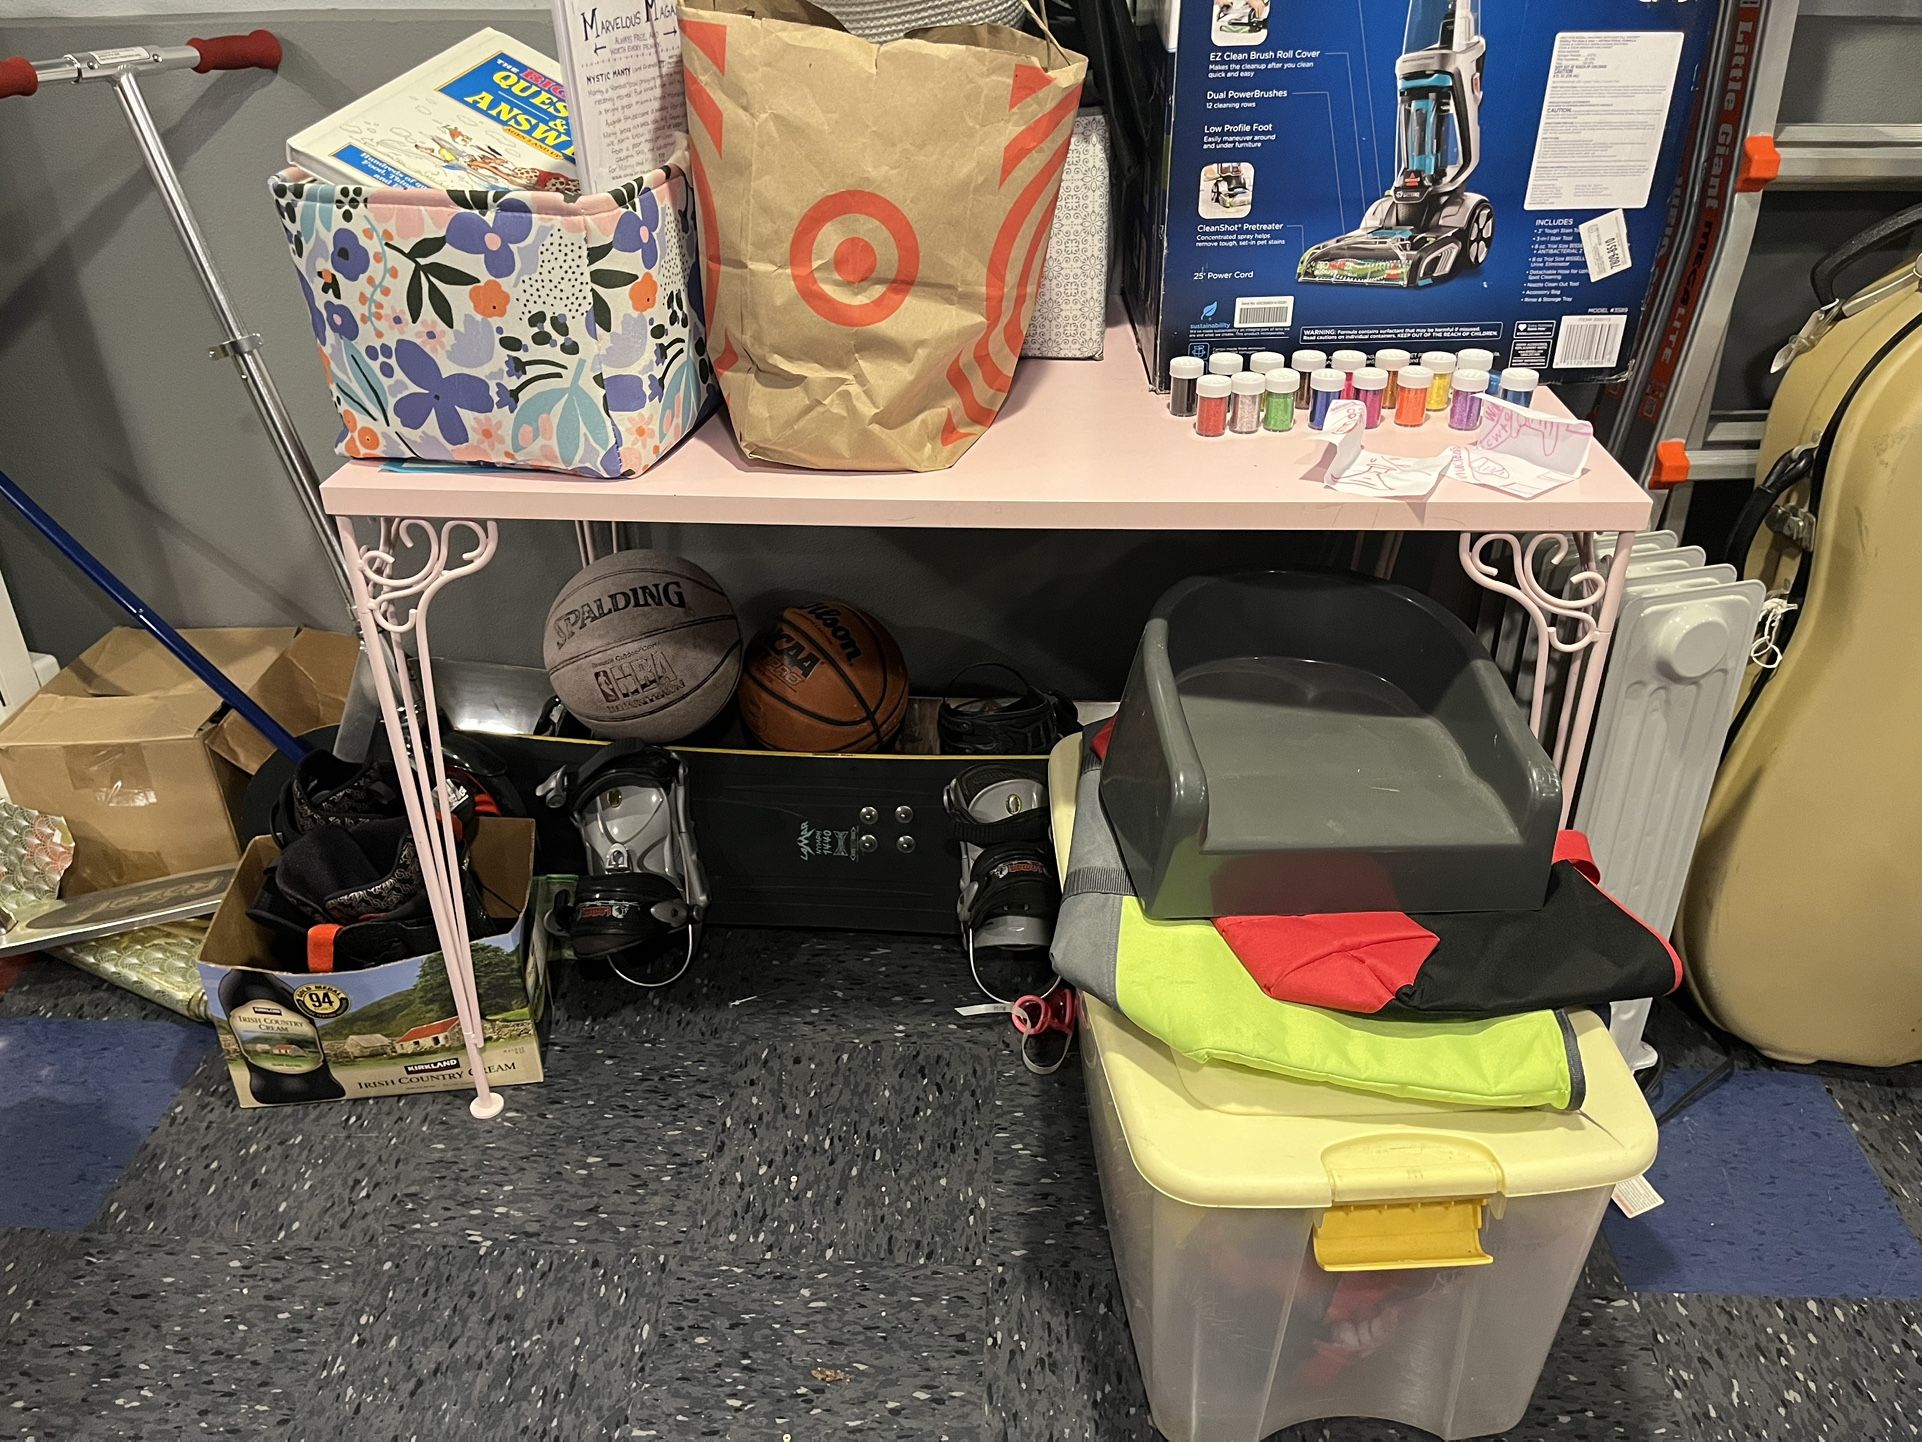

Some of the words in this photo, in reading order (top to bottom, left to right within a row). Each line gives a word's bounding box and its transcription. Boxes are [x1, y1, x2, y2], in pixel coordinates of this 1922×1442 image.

[580, 8, 641, 41] MARVELOUS
[644, 0, 677, 24] MAGA
[614, 35, 632, 44] ALWAYS
[1210, 52, 1222, 61] EZ
[1224, 52, 1248, 60] Clean
[1250, 51, 1274, 60] Brush
[1276, 50, 1294, 59] Roll
[1295, 50, 1320, 58] Cover
[496, 58, 520, 74] THE
[1724, 22, 1753, 111] Little
[586, 72, 611, 85] MYSTIC
[612, 67, 630, 80] MANTY
[492, 70, 568, 117] QUES
[1206, 91, 1226, 100] Dual
[1228, 89, 1288, 99] PowerBrushes
[548, 119, 568, 132] &
[1204, 125, 1222, 133] Low
[1224, 124, 1251, 132] Profile
[1252, 123, 1273, 132] Foot
[360, 152, 404, 178] Hundreds
[1705, 123, 1733, 208] Giant
[1243, 223, 1284, 231] Pretreater
[1208, 272, 1233, 280] Power
[1234, 270, 1254, 278] Cord
[553, 581, 686, 650] SPALDING
[822, 830, 832, 856] 1440
[297, 986, 312, 998] GOLD
[314, 985, 342, 996] MEDAL
[308, 992, 334, 1008] 94
[258, 1024, 290, 1032] CREAM
[263, 1017, 304, 1028] COUNTRY
[407, 1059, 458, 1073] KIRKLAND
[358, 1078, 395, 1090] IRISH
[398, 1070, 464, 1085] COUNTRY
